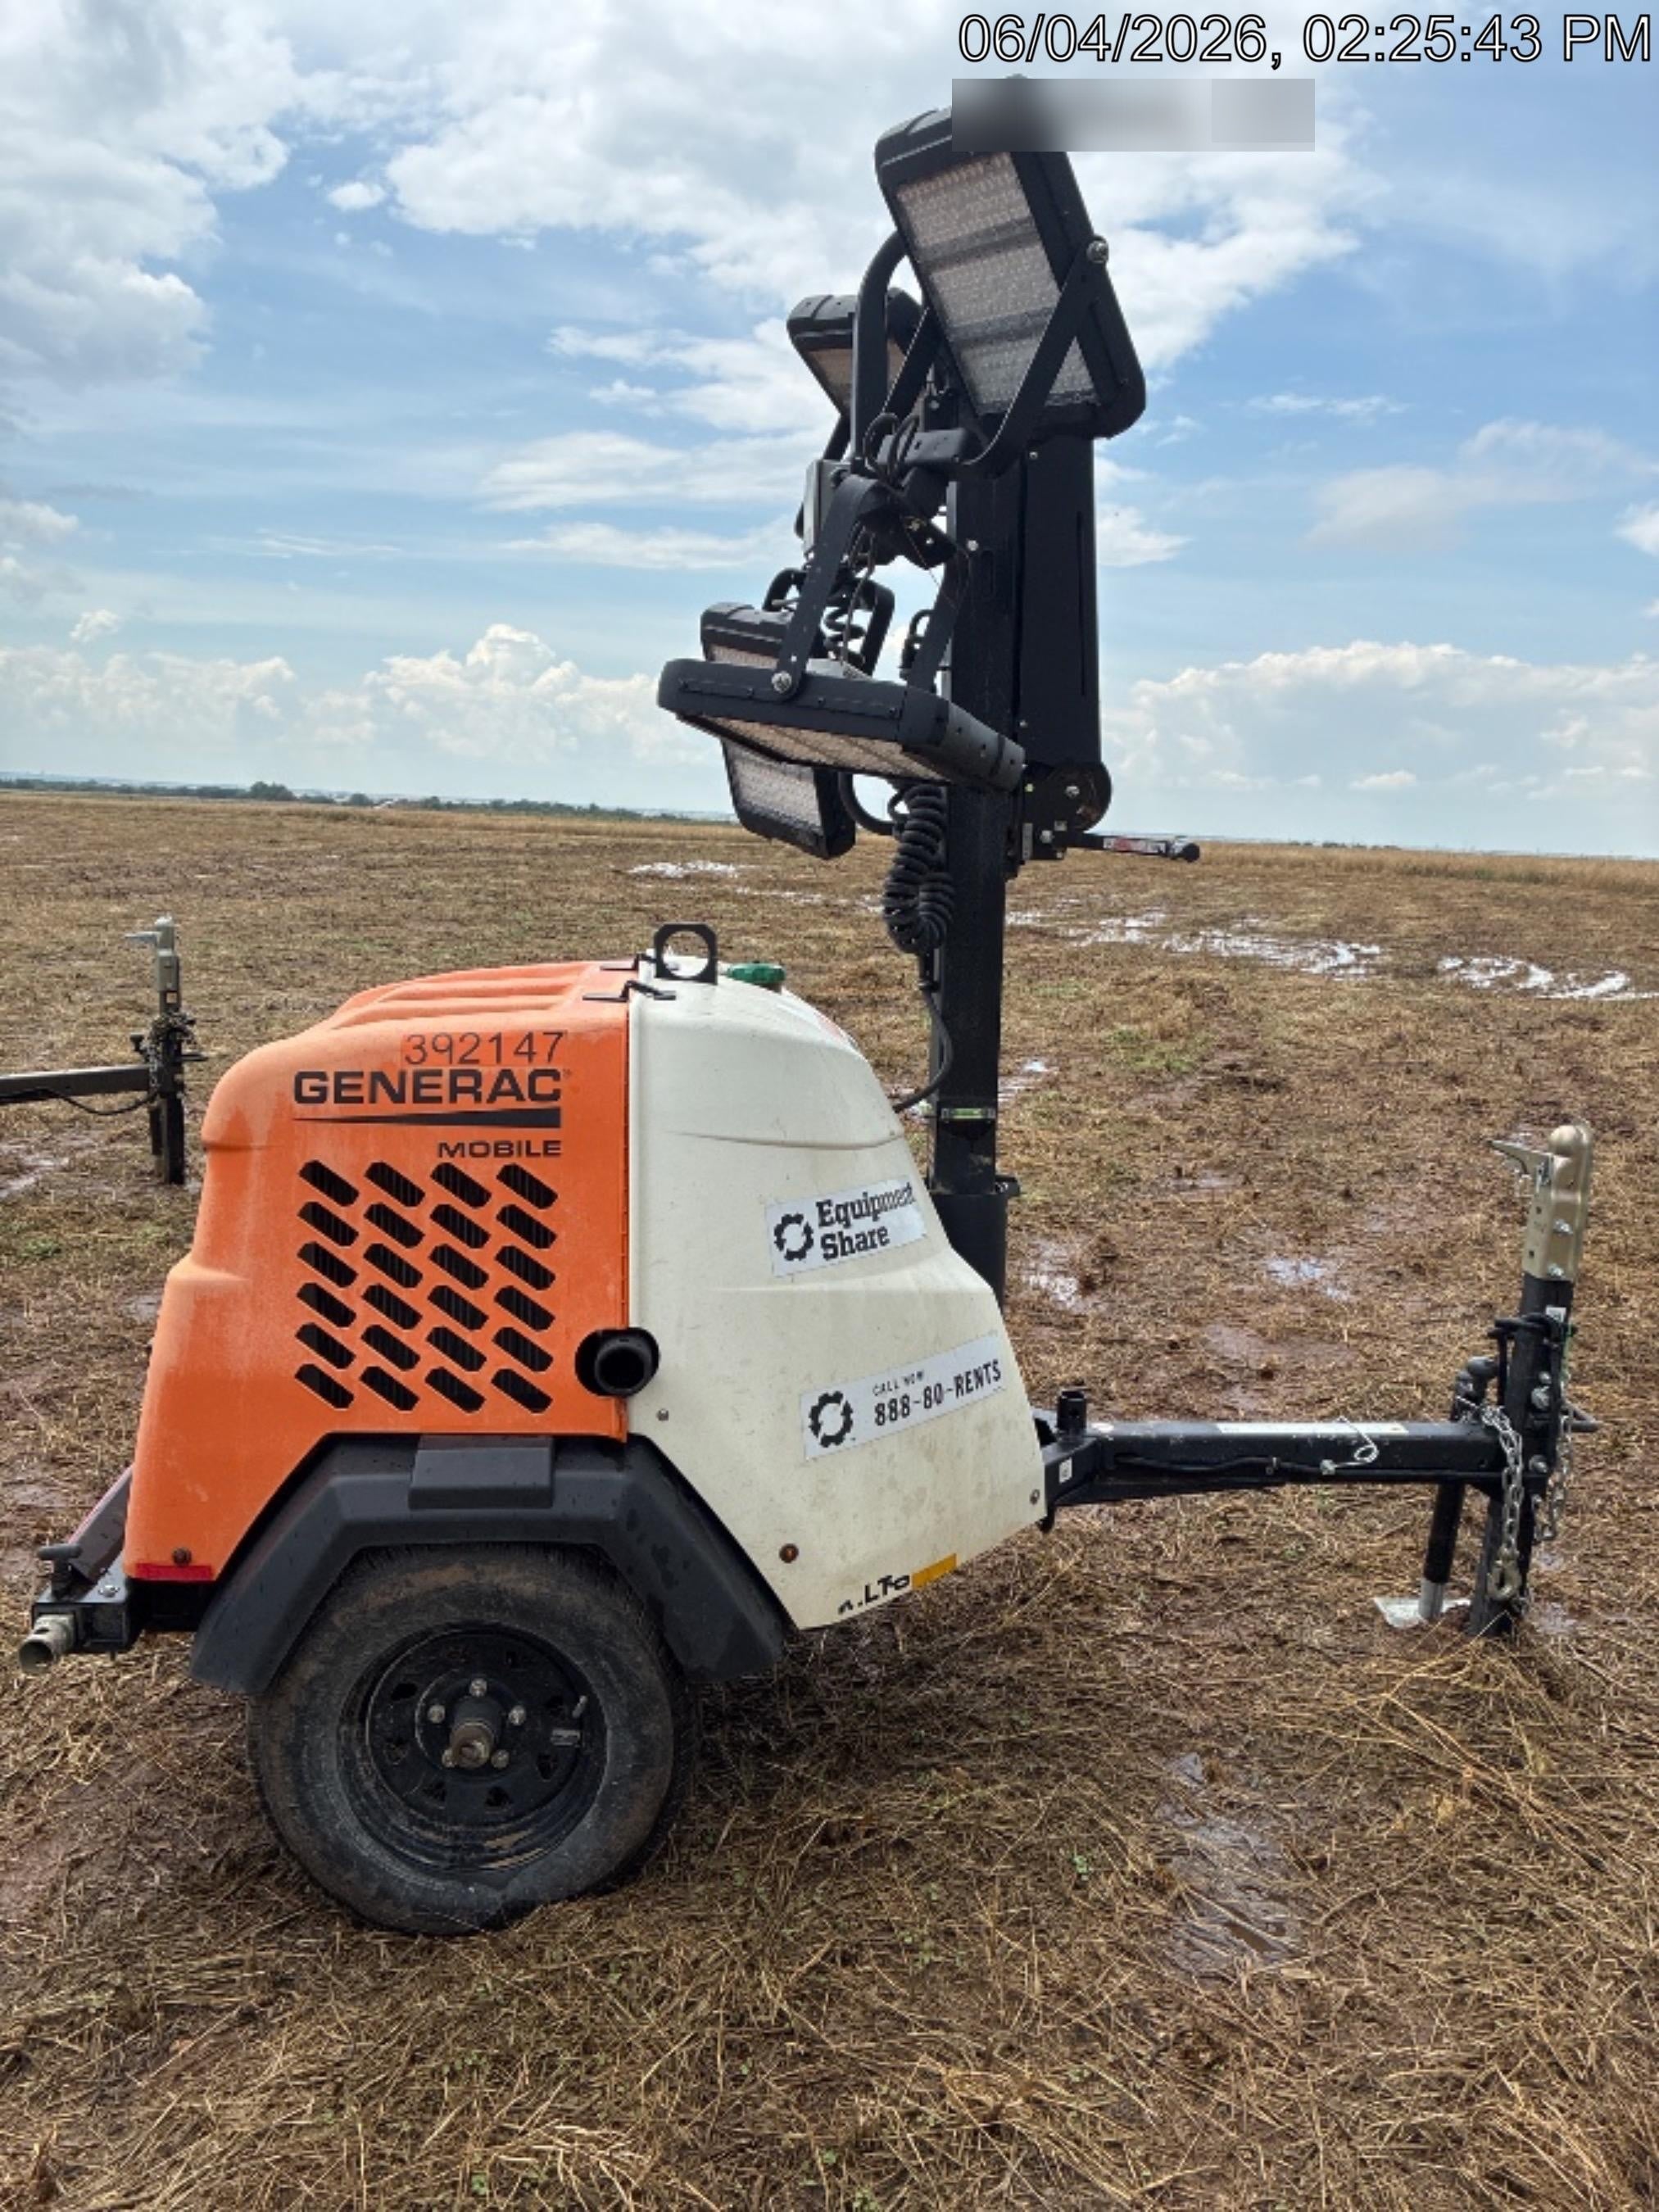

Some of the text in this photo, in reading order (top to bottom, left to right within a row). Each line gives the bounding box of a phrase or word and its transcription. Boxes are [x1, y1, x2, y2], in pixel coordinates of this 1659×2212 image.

[405, 1030, 565, 1065] 392147
[293, 1068, 562, 1105] GENERAC
[437, 1140, 562, 1158] MOBILE
[815, 1181, 917, 1228] Equipment
[821, 1226, 891, 1261] Share
[872, 1376, 900, 1396] CALL
[873, 1359, 1002, 1426] 888-80-RENTS
